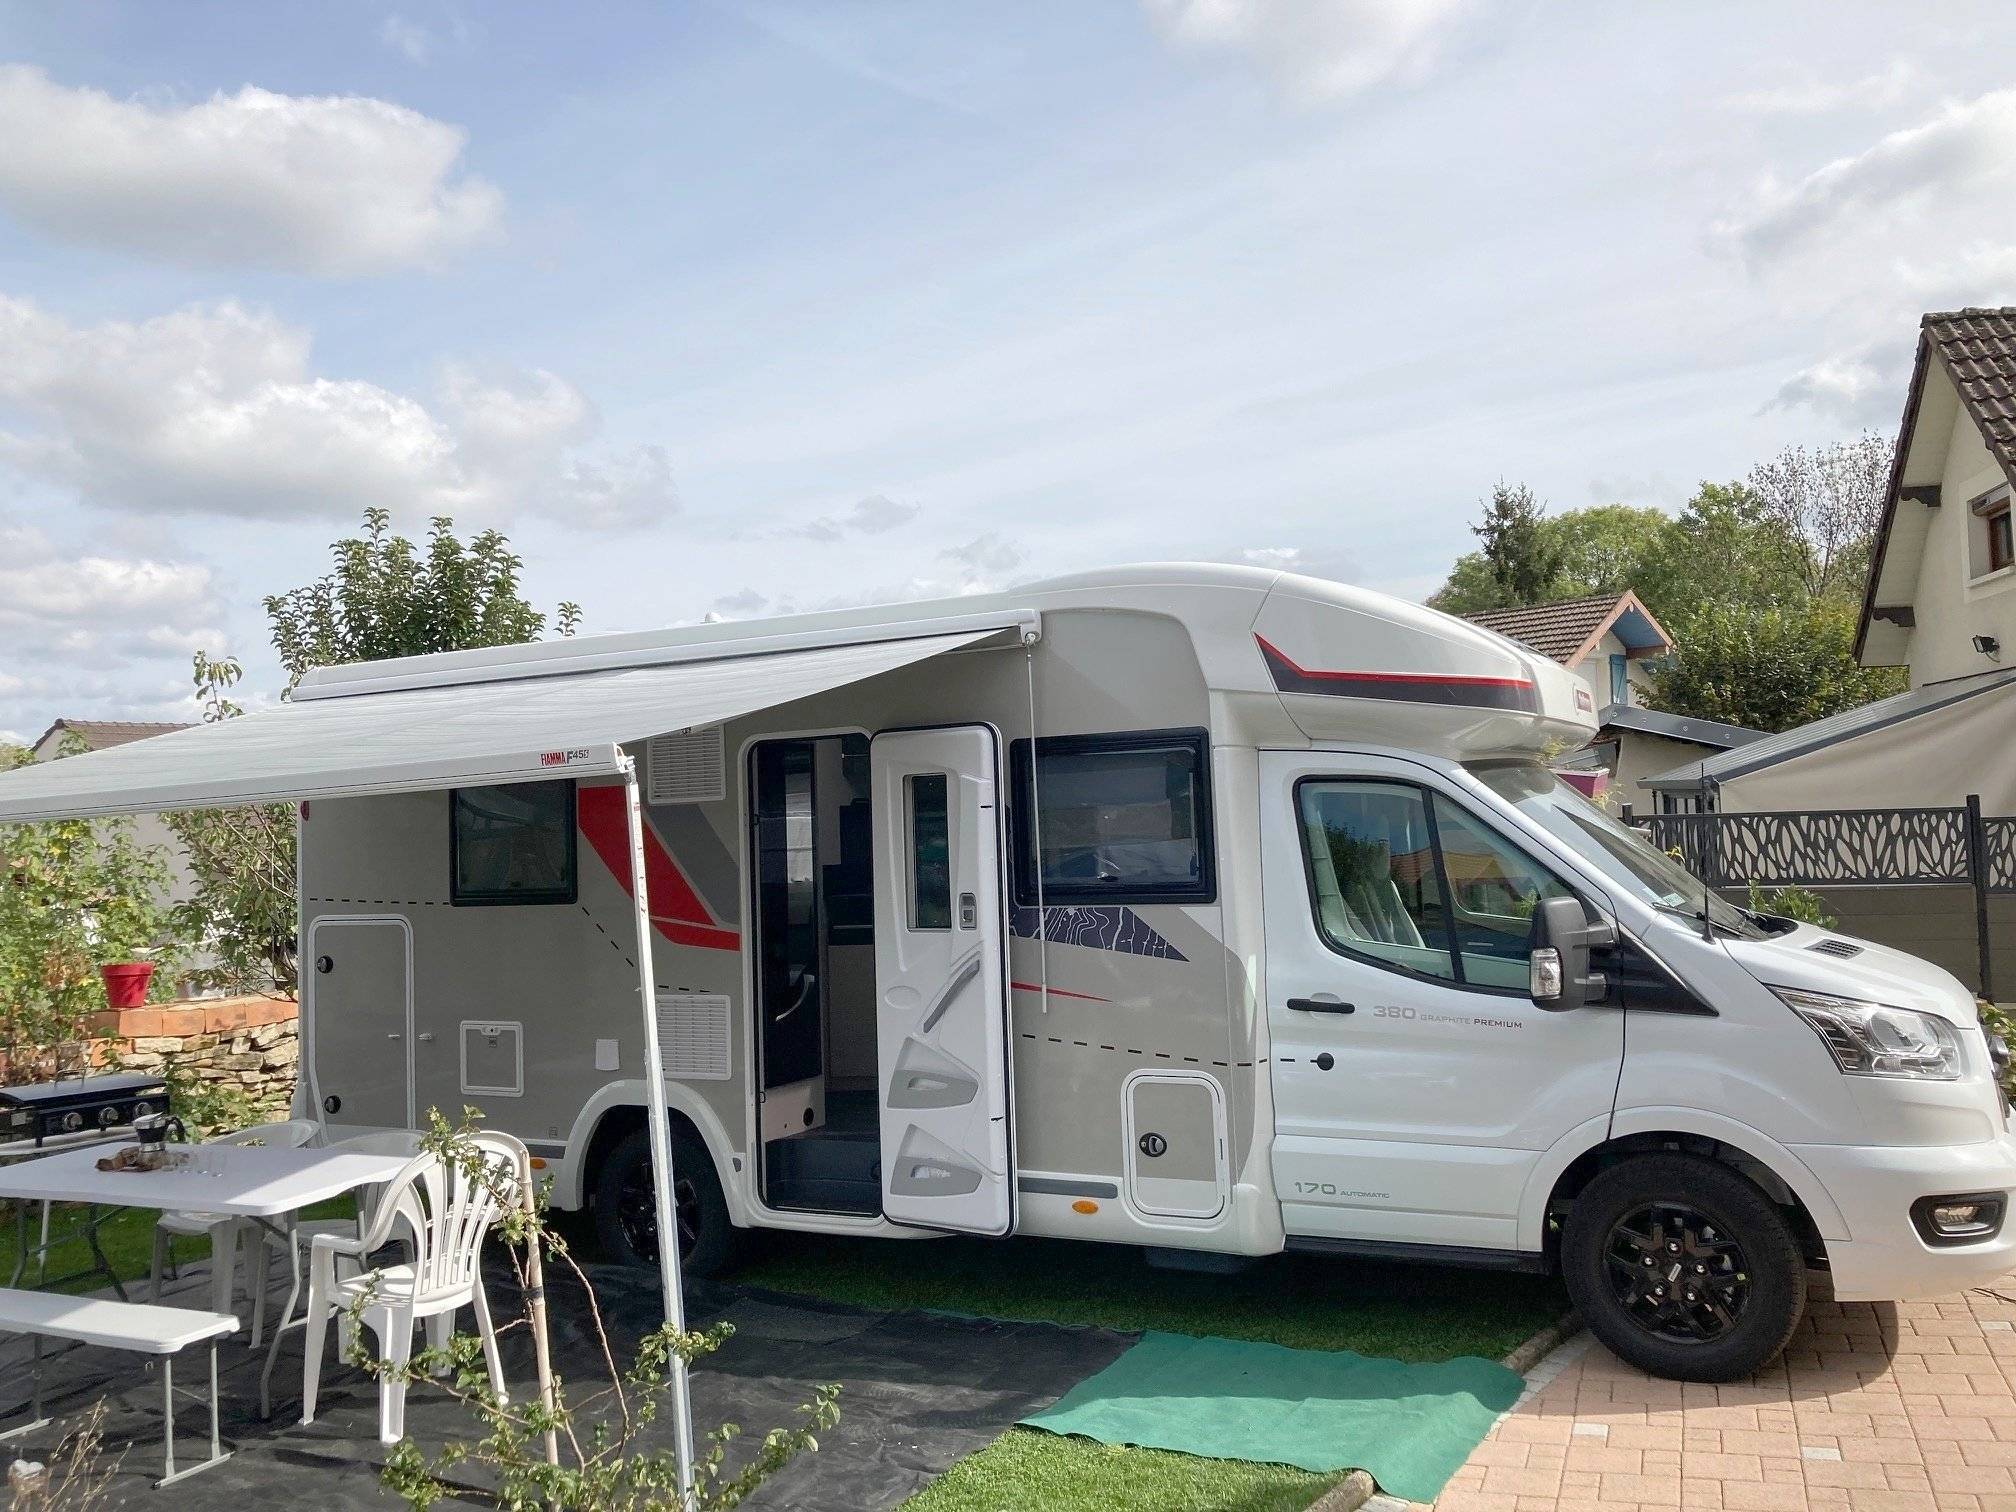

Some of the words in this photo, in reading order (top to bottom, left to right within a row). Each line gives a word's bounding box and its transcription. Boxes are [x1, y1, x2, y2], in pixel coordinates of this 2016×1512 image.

[541, 752, 566, 766] FIAMMA
[1373, 1005, 1416, 1019] 380
[1420, 1014, 1471, 1024] GRAPHITE
[1473, 1018, 1522, 1028] PREMIUM
[1294, 1182, 1336, 1195] 170
[1340, 1190, 1390, 1199] AUTOMATIC
